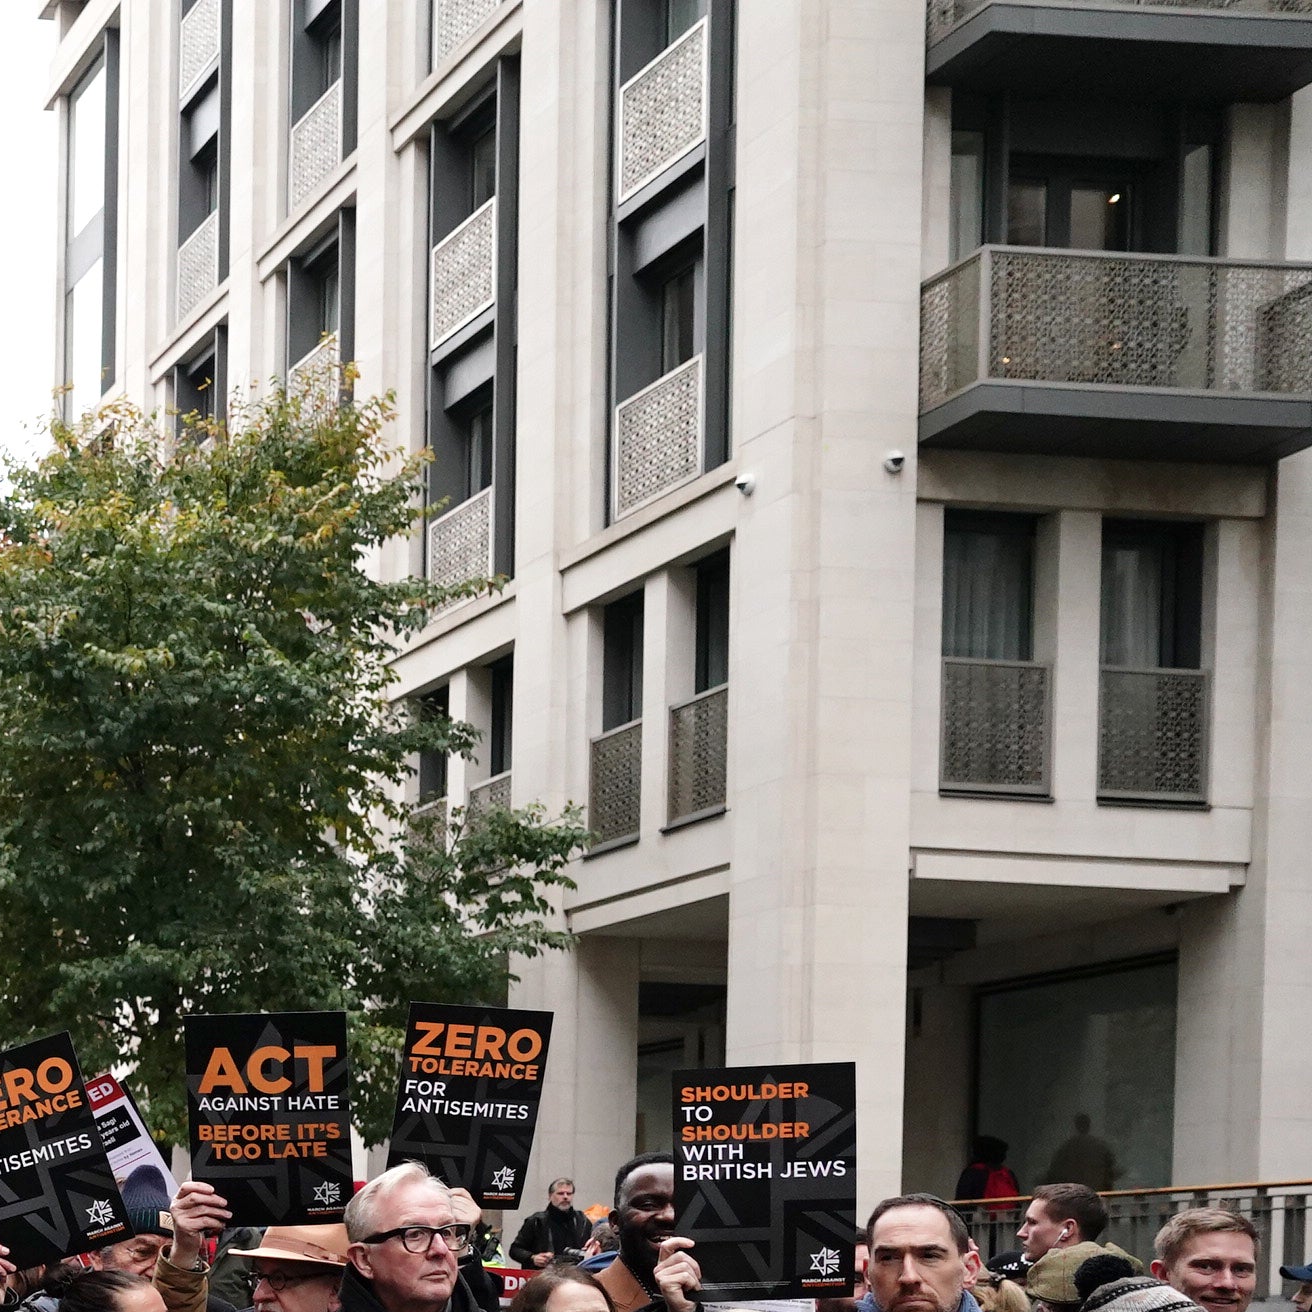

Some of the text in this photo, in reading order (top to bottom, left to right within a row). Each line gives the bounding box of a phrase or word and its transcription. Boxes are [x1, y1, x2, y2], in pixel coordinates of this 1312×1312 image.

[411, 1021, 542, 1063] ZERO
[198, 1045, 337, 1095] ACT
[408, 1056, 539, 1080] TOLERANCE
[405, 1079, 446, 1096] FOR
[681, 1082, 809, 1103] SHOULDER
[198, 1095, 339, 1111] AGAINST HATE
[401, 1097, 529, 1120] ANTISEMITES
[681, 1105, 713, 1122] TO
[119, 1120, 130, 1129] old
[198, 1122, 341, 1141] BEFORE IT'S
[681, 1122, 810, 1142] SHOULDER
[211, 1142, 328, 1160] TOO LATE
[682, 1144, 744, 1161] WITH
[682, 1160, 846, 1181] BRITISH JEWS
[86, 1222, 123, 1236] MARCH AGAINST
